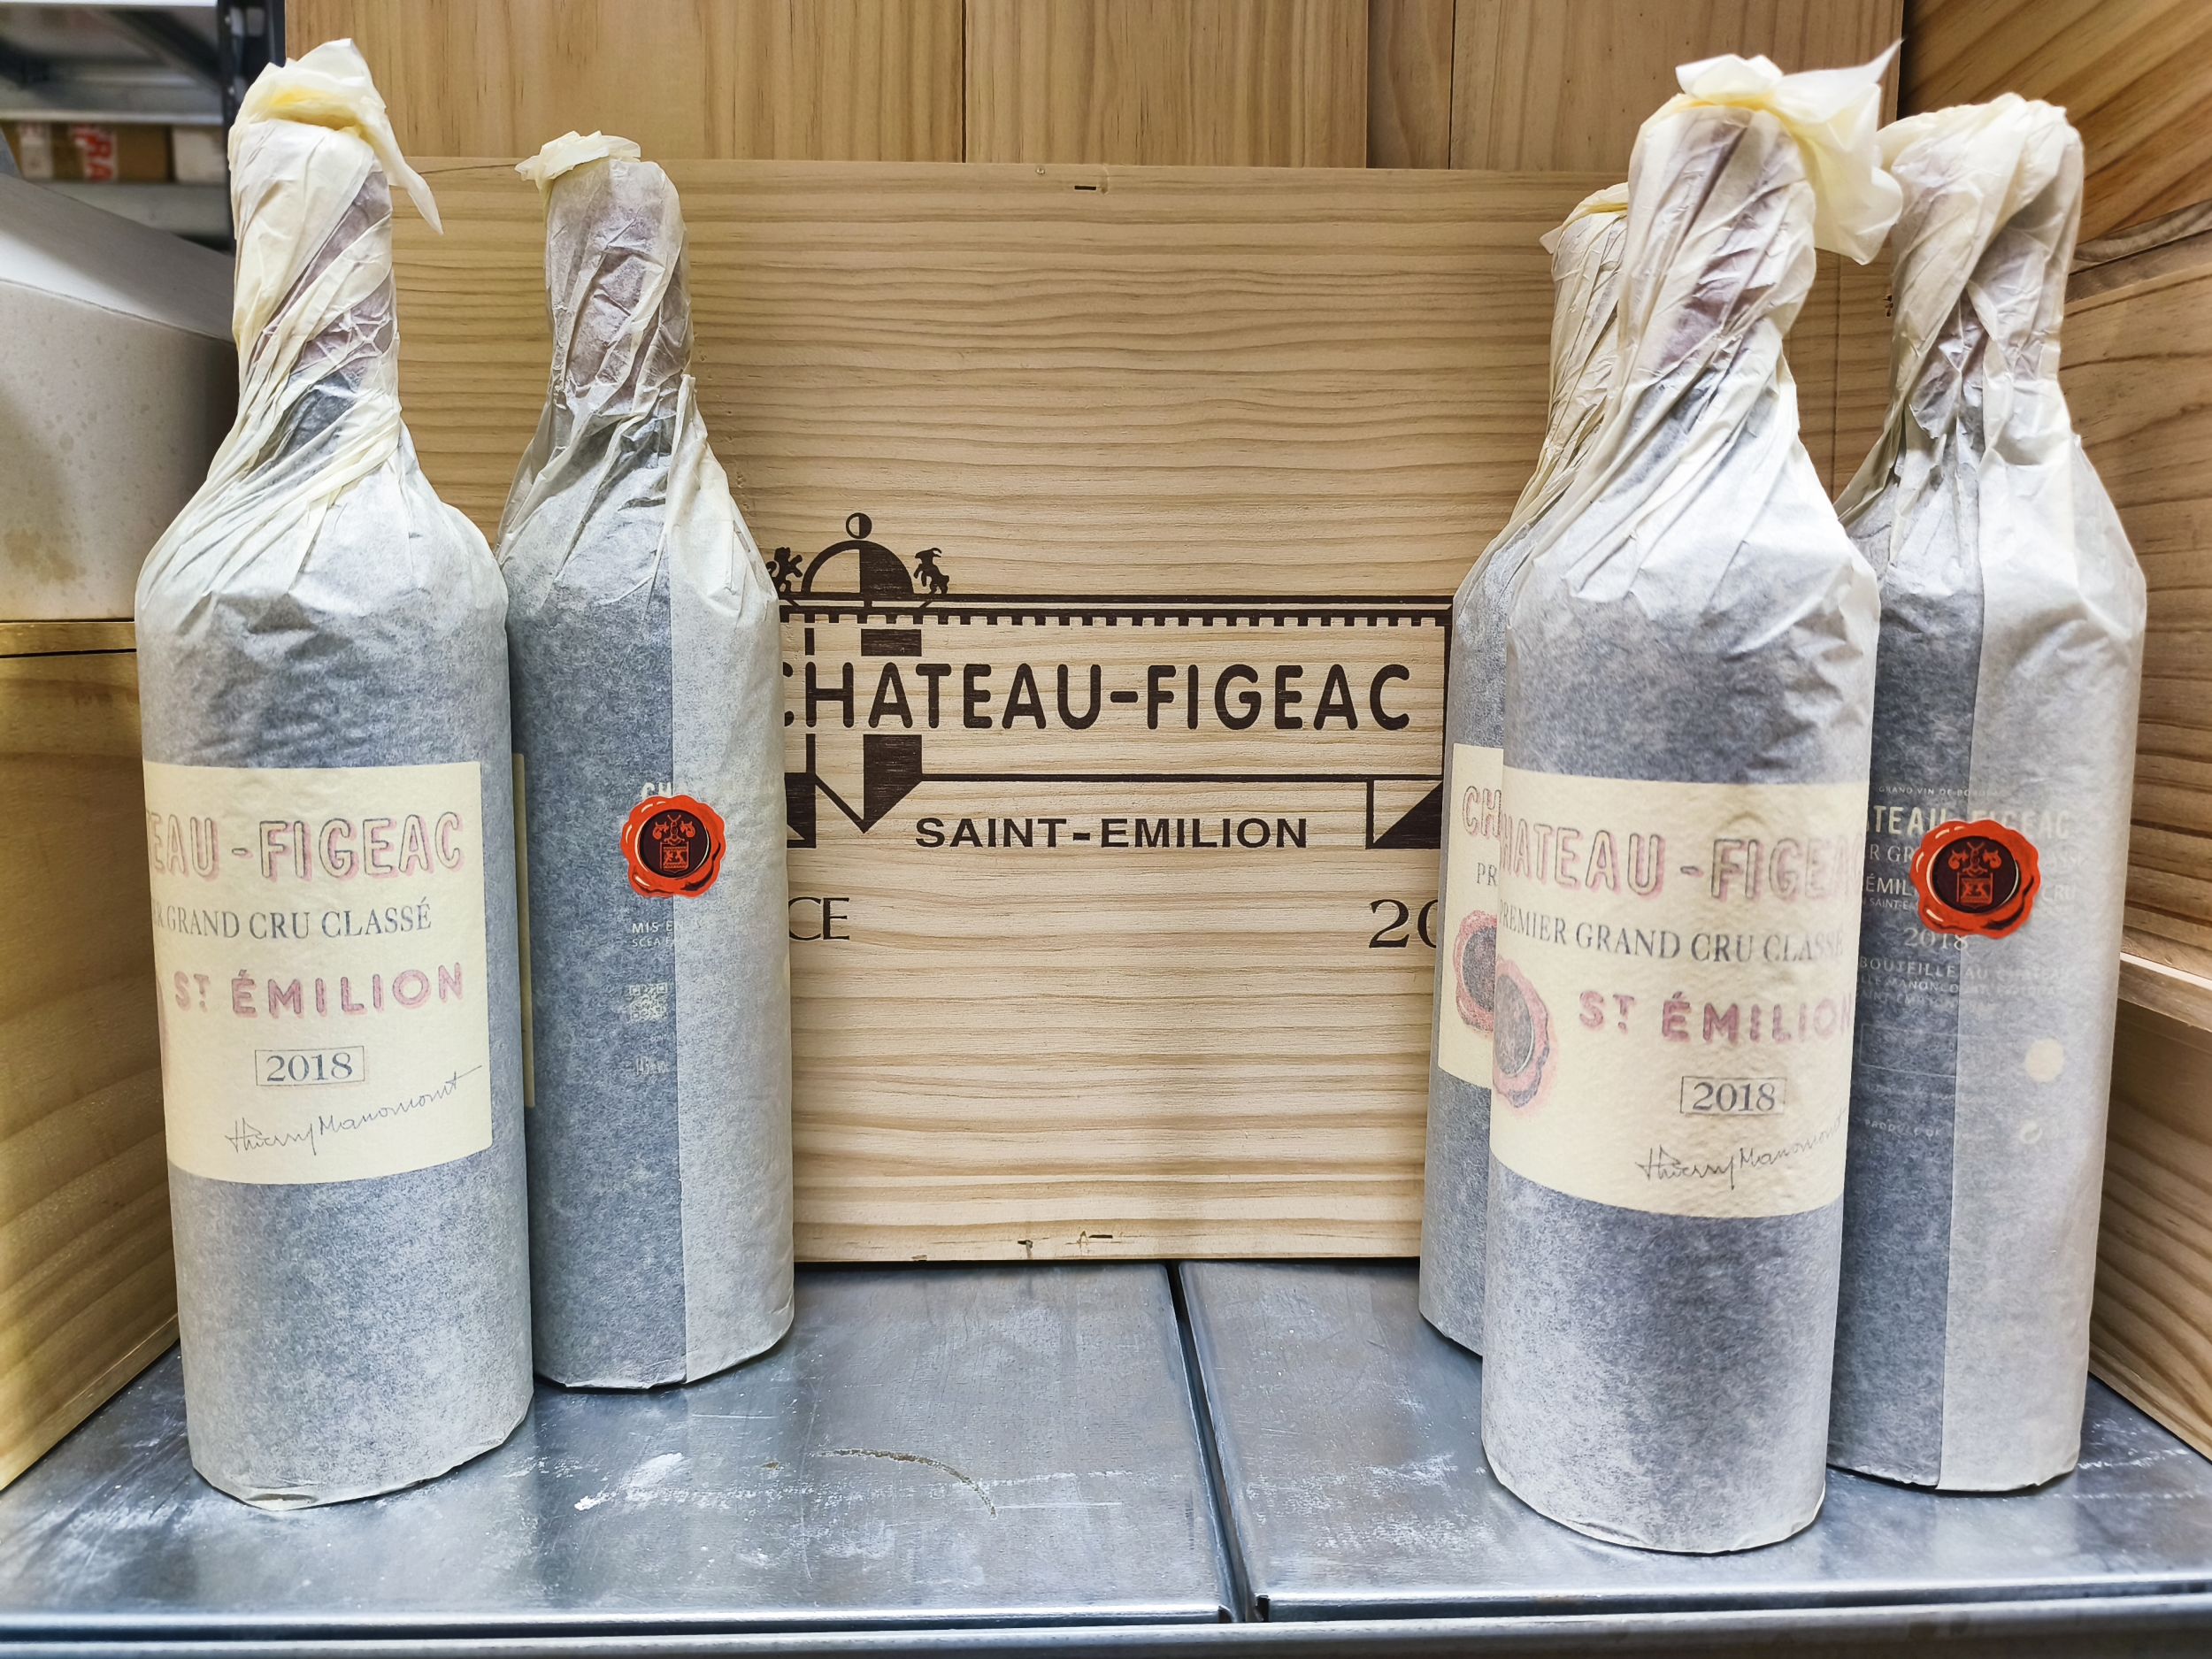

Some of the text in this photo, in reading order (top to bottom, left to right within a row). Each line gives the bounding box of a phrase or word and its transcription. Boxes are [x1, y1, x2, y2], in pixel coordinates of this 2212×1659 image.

[1878, 786, 1914, 795] GRAND
[147, 810, 465, 882] EAU-FIGEAC
[916, 817, 1309, 849] SAINT-EMILION
[167, 905, 240, 939] GRAND
[250, 911, 311, 939] CRU
[321, 897, 433, 937] CLASSÉ
[631, 921, 659, 934] MIS
[788, 896, 850, 941] CE
[1575, 920, 1681, 959] GRAND
[1691, 933, 1754, 963] CRU
[1904, 926, 1969, 951] 2018
[231, 963, 465, 1019] ÉMILION
[1661, 988, 1853, 1046] ÉMILION
[266, 1051, 353, 1082] 2018
[1692, 1081, 1777, 1112] 2018
